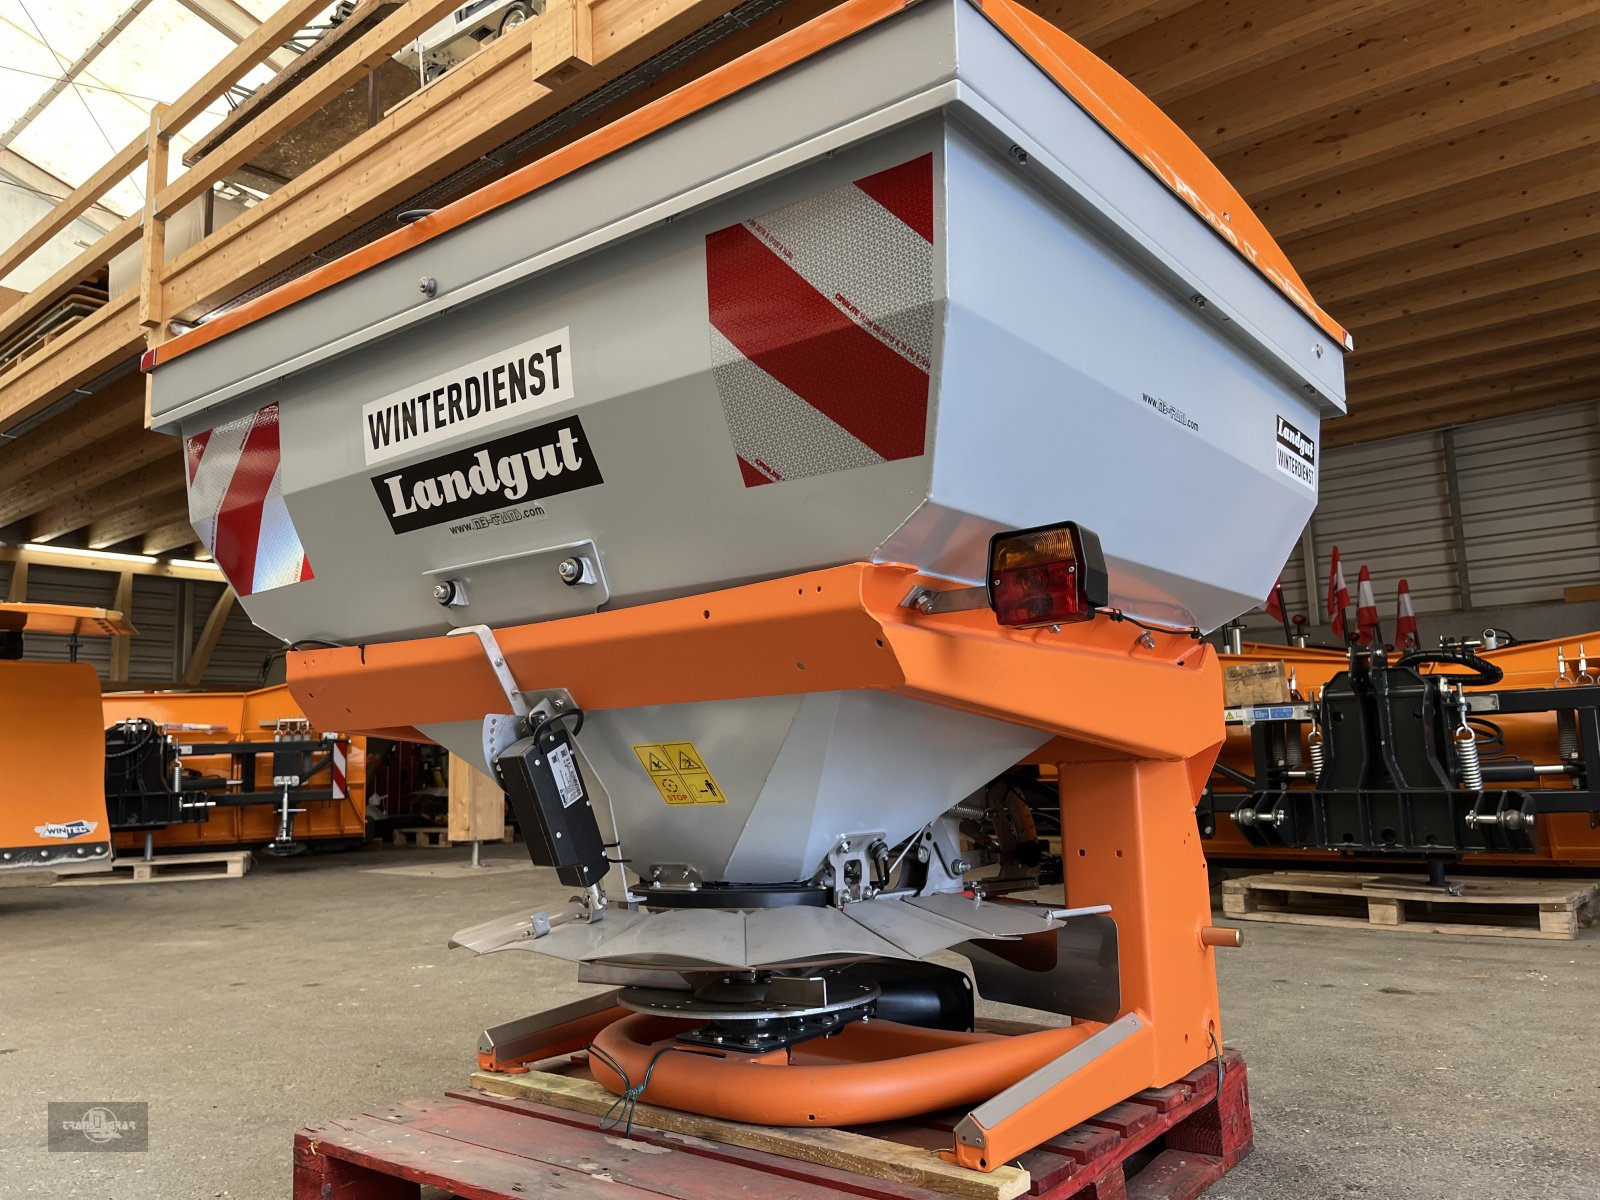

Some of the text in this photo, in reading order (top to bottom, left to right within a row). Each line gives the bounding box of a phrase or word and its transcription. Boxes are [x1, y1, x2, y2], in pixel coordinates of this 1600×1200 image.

[367, 344, 562, 450] WINTERDIENST
[1277, 417, 1314, 458] Landgut
[384, 427, 583, 518] Landgut
[1277, 447, 1314, 486] WINTERDIENST
[667, 794, 688, 802] STOP
